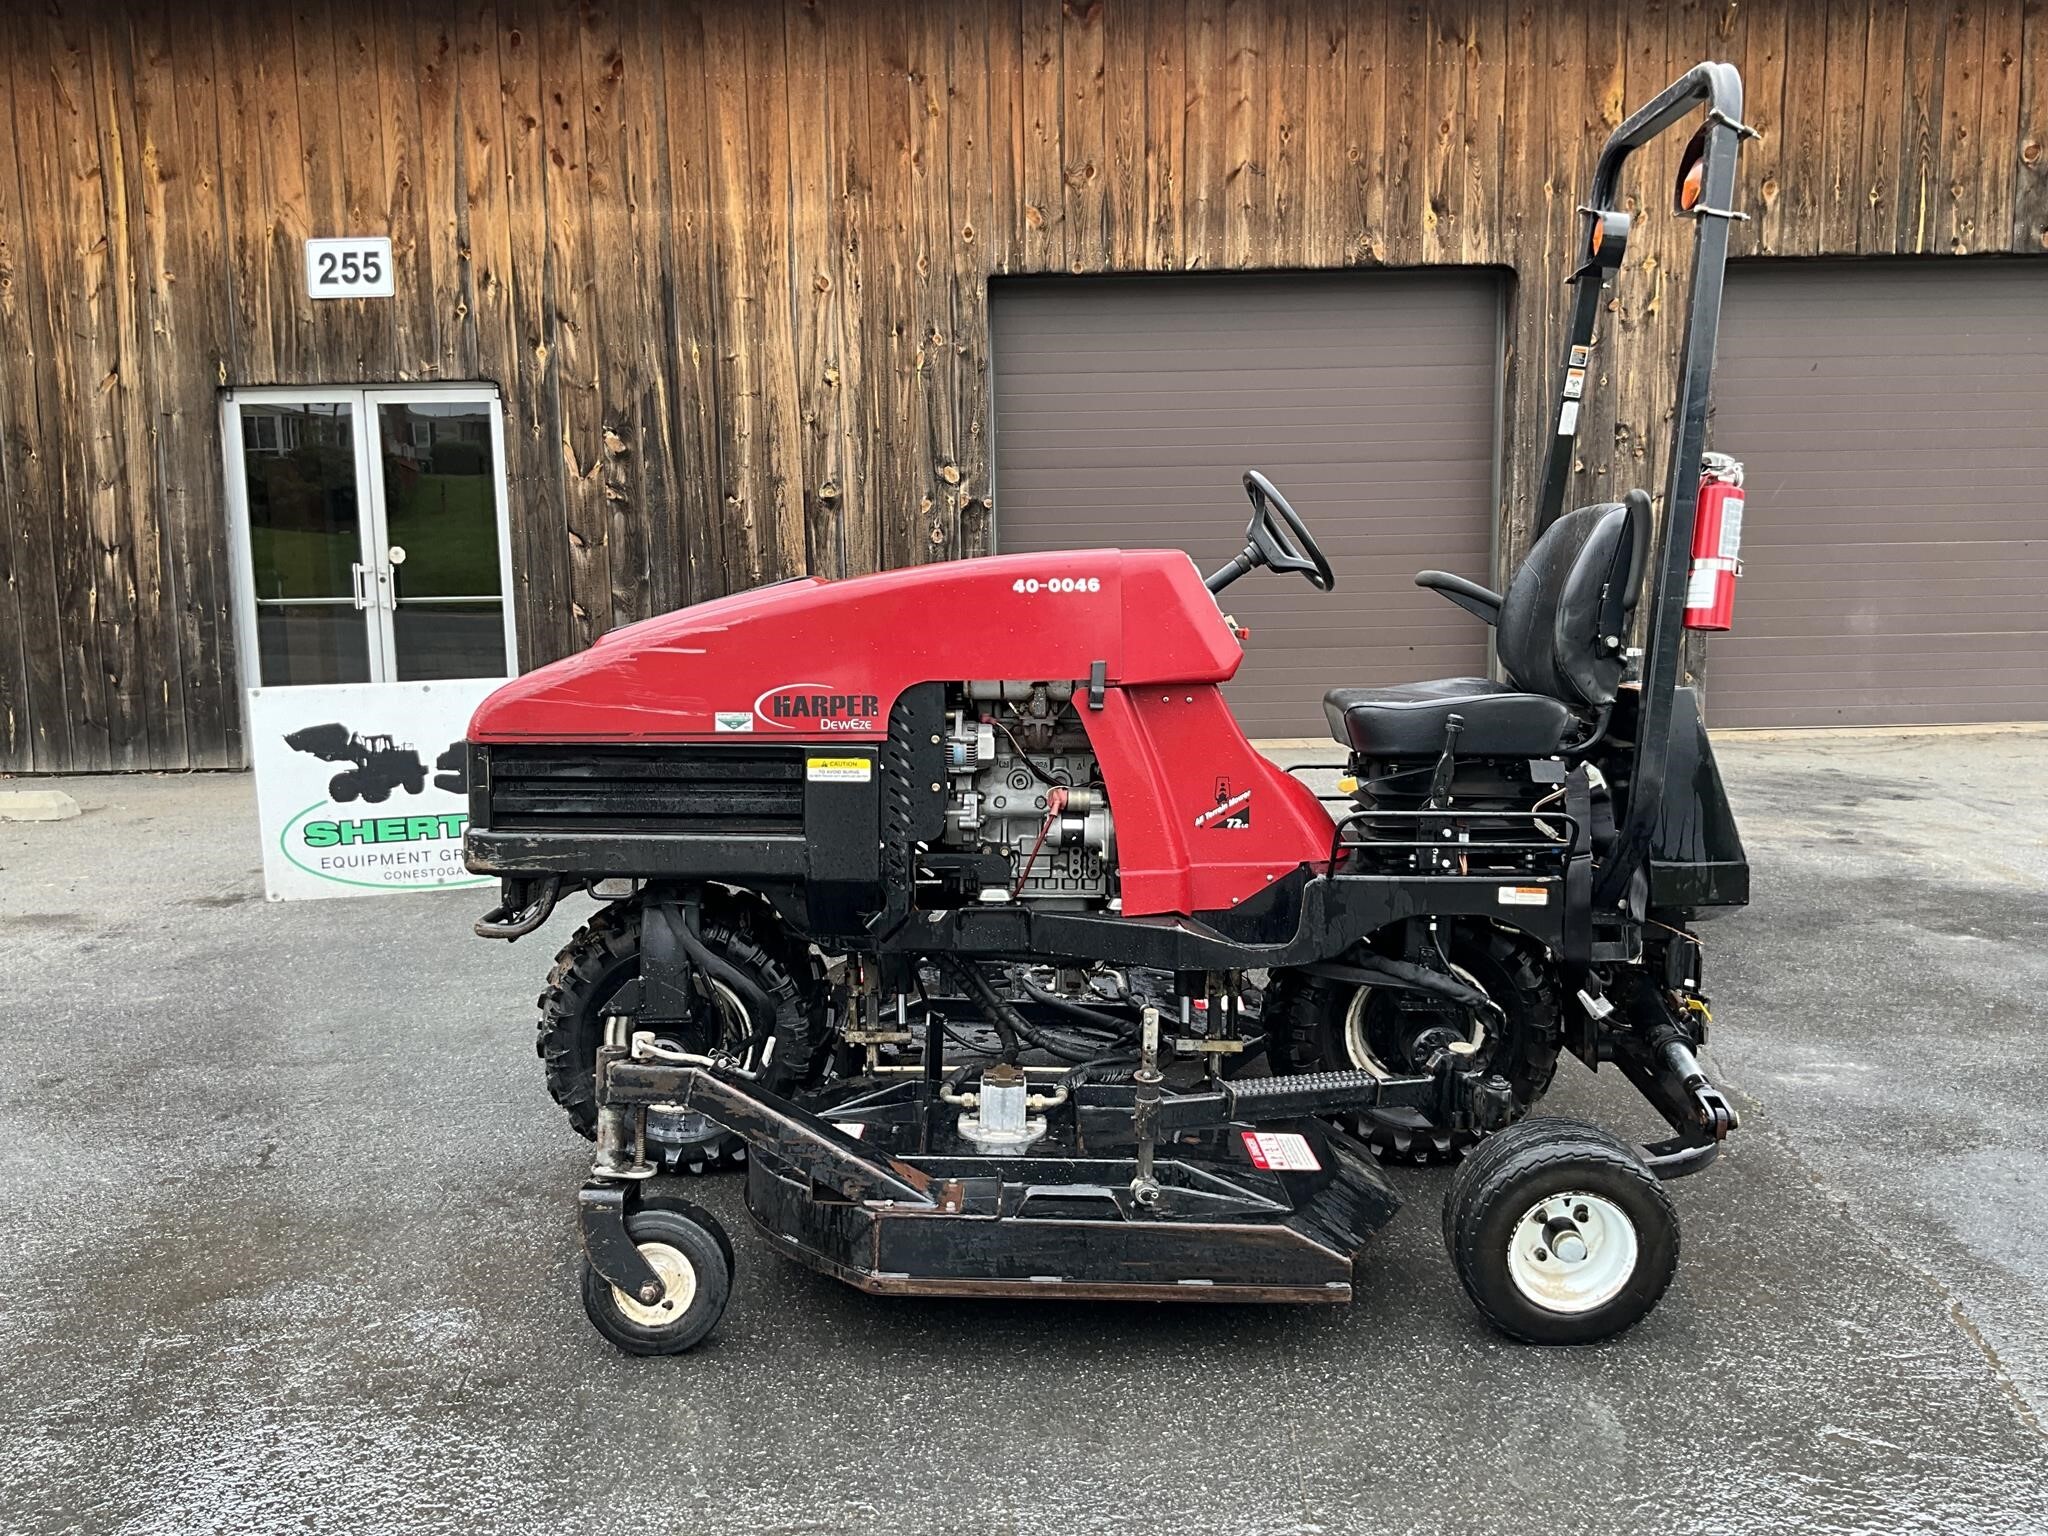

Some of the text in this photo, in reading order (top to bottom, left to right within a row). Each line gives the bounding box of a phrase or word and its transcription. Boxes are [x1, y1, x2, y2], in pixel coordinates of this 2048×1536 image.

[318, 251, 382, 284] 255
[1012, 577, 1101, 593] 40-0046
[773, 695, 878, 717] HARPER
[829, 760, 858, 768] CAUTION
[1204, 802, 1229, 820] Terrain
[1228, 789, 1251, 808] Mower
[304, 813, 469, 848] SHERT
[321, 850, 432, 870] EQUIPMENT
